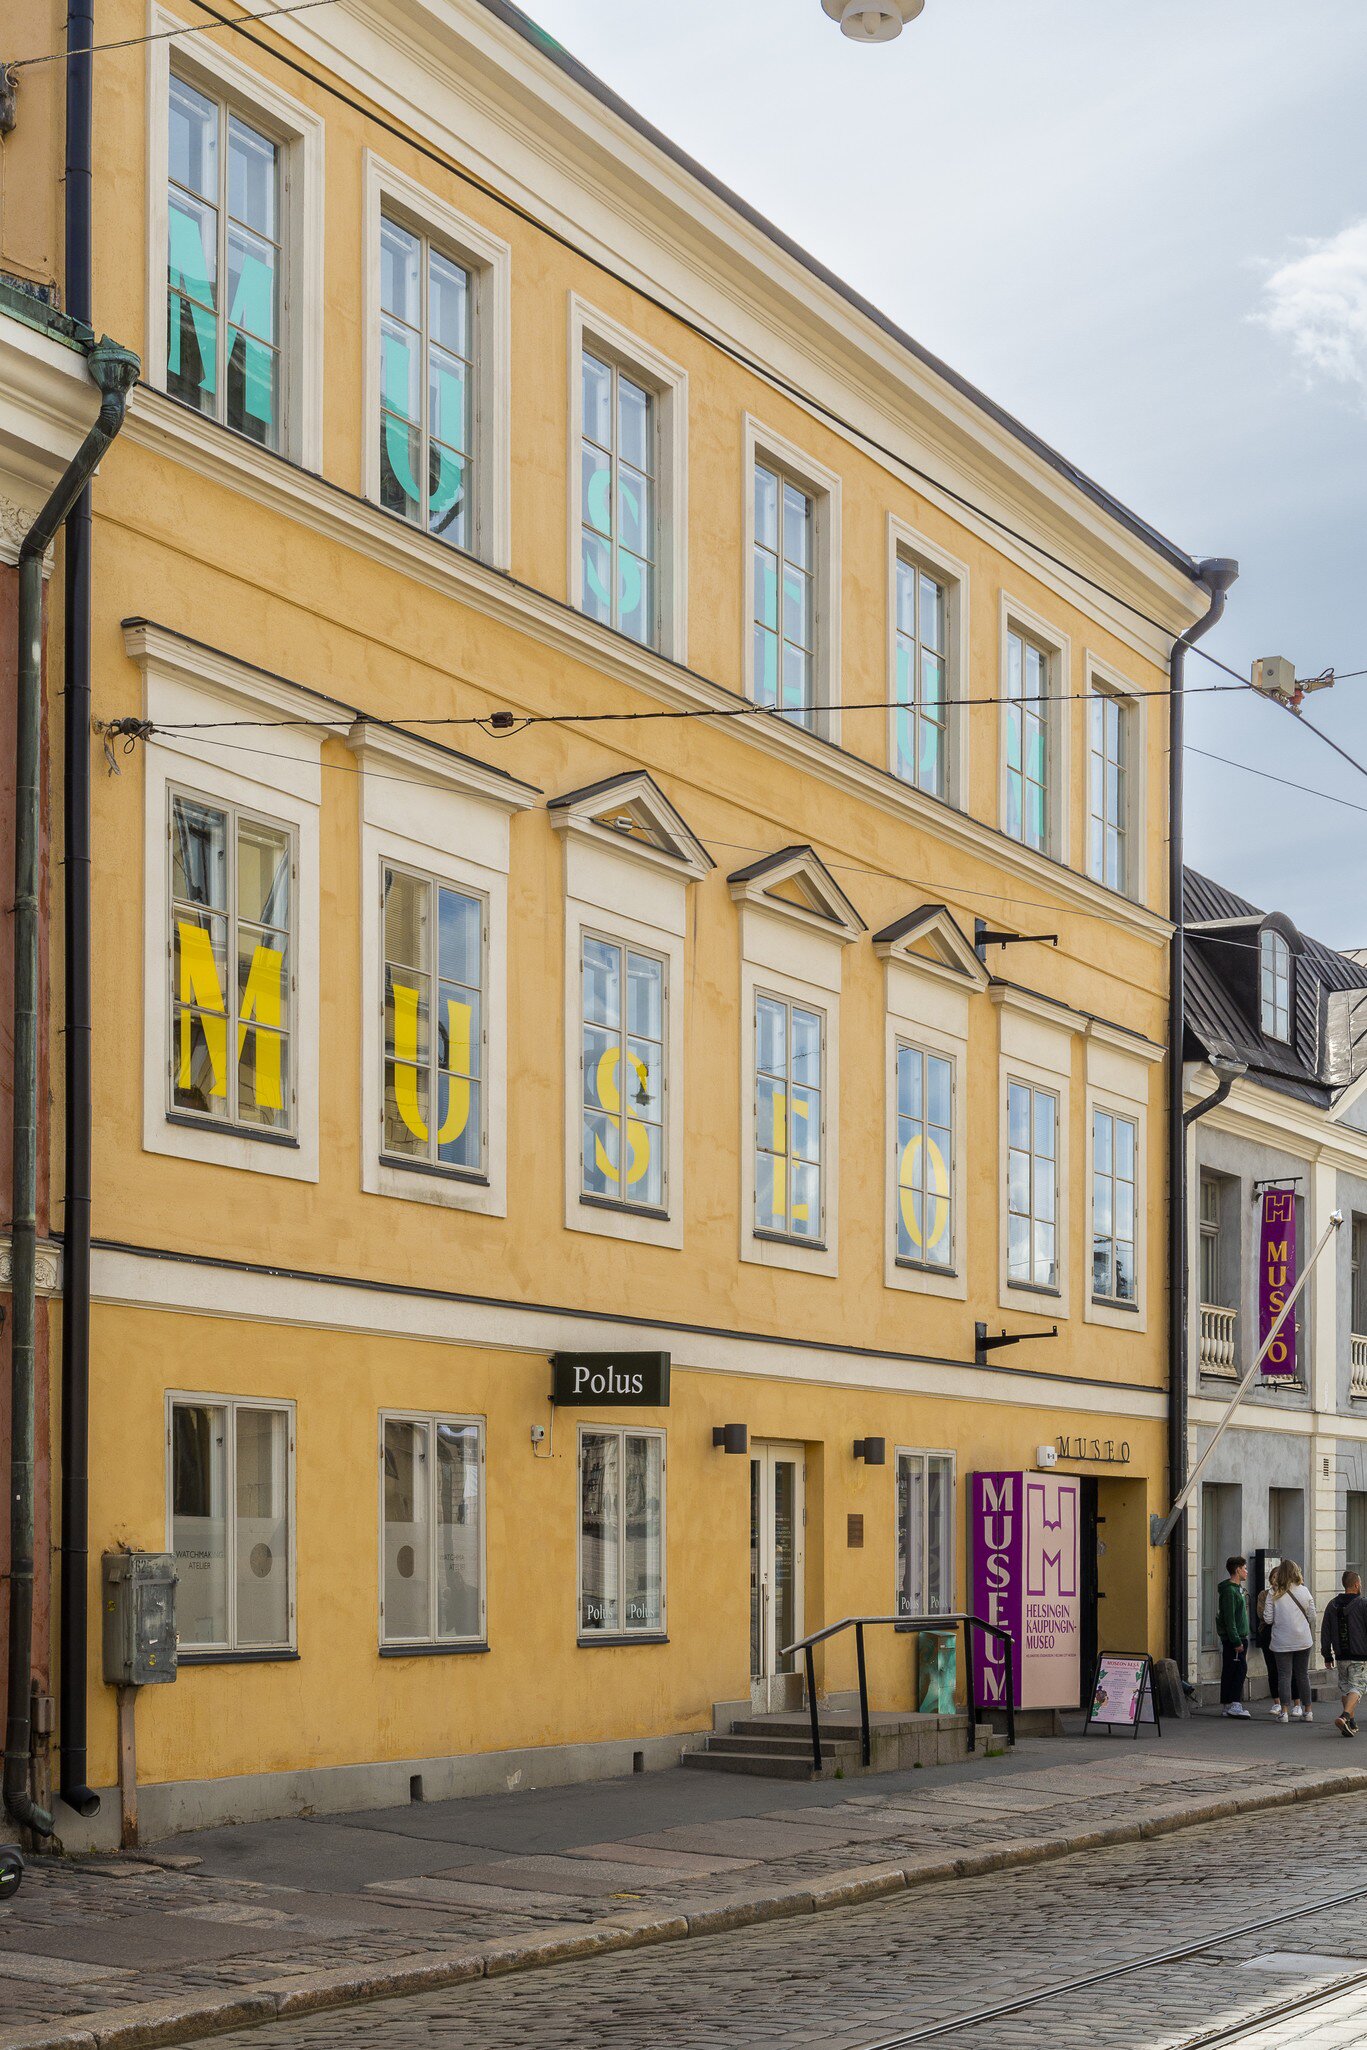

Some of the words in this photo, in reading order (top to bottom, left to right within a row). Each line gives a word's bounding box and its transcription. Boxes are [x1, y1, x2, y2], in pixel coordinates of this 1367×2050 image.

[572, 1365, 644, 1394] Polus
[1056, 1436, 1130, 1462] MUSEO
[188, 1562, 211, 1570] ATELIER
[982, 1478, 1014, 1700] MUSEUM
[587, 1604, 613, 1619] Polus
[630, 1603, 655, 1618] Polus
[1026, 1604, 1070, 1618] HELSINGIN
[1026, 1620, 1077, 1633] KAUPUNGIN-
[1026, 1635, 1055, 1649] MUSEO
